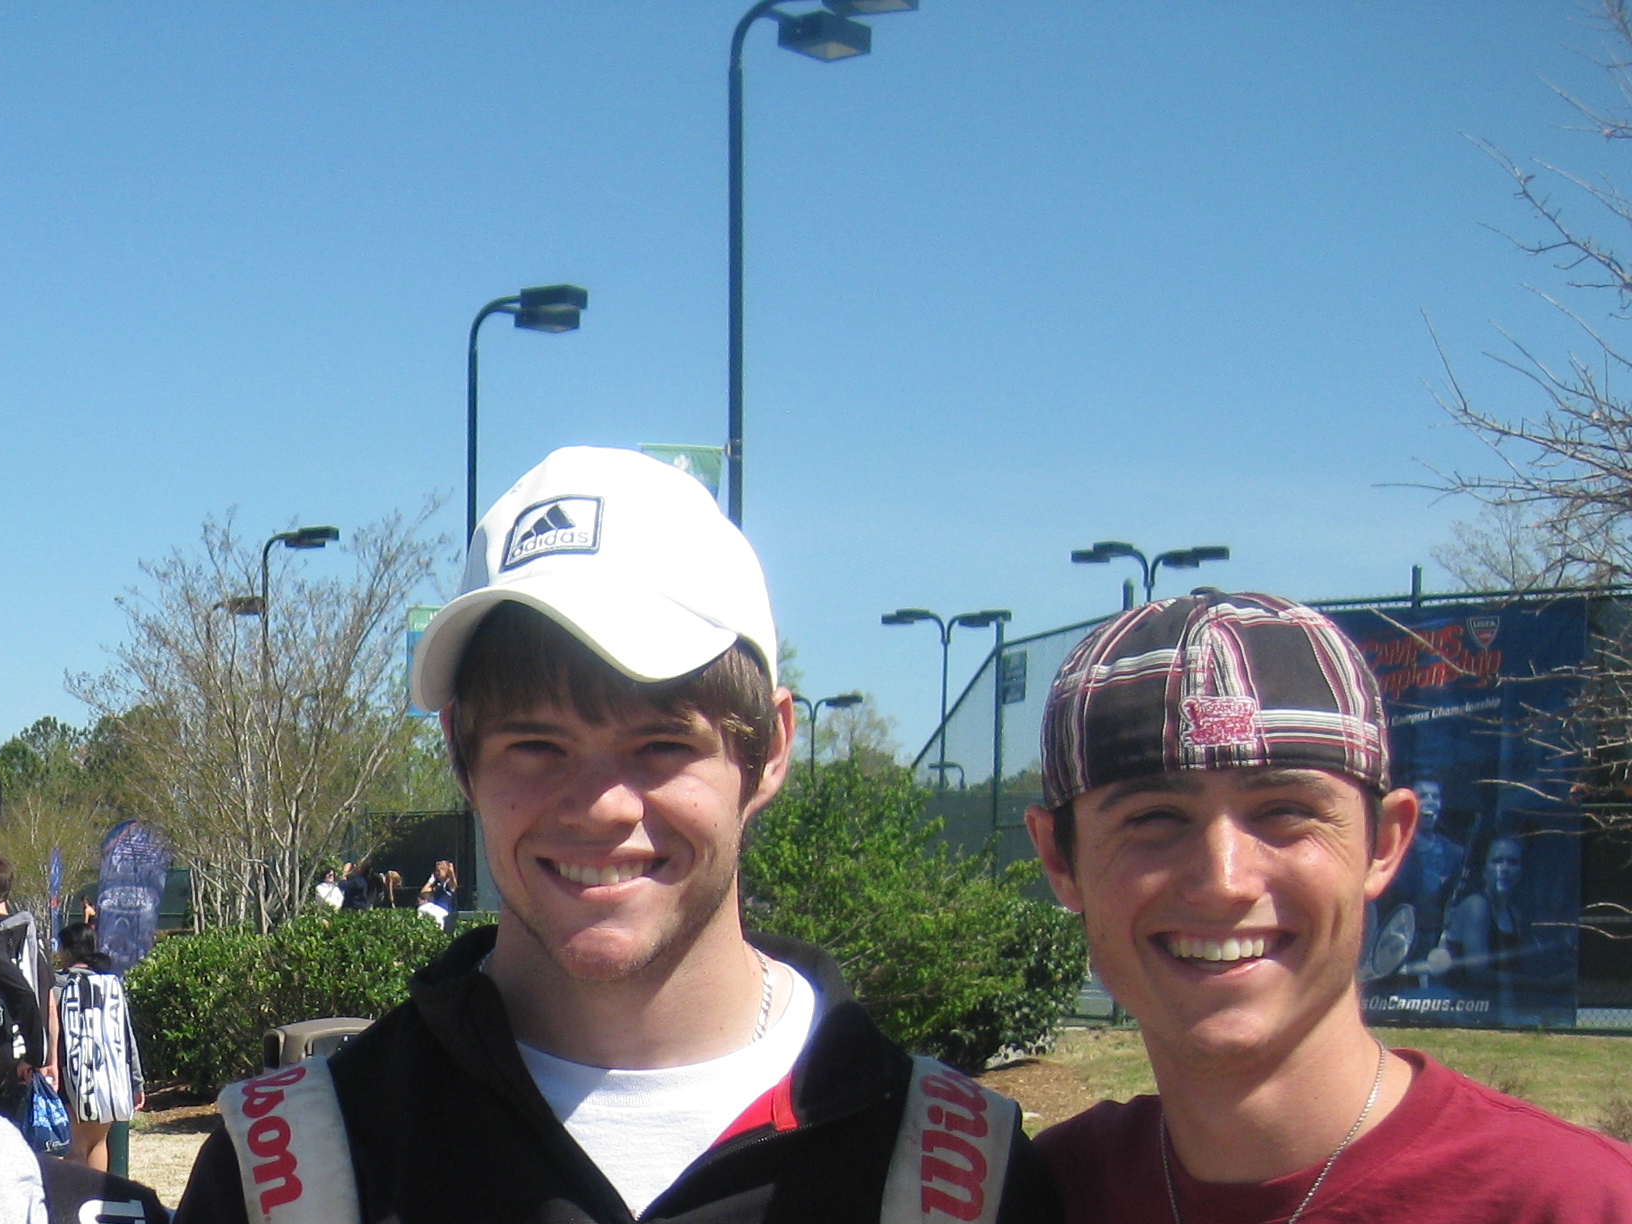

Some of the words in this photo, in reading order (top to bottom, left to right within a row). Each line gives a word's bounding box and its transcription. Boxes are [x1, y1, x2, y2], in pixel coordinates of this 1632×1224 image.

[511, 529, 589, 558] adidas
[1473, 620, 1496, 628] USTA
[1362, 995, 1490, 1013] sOnCampus.com
[242, 1066, 306, 1216] lson
